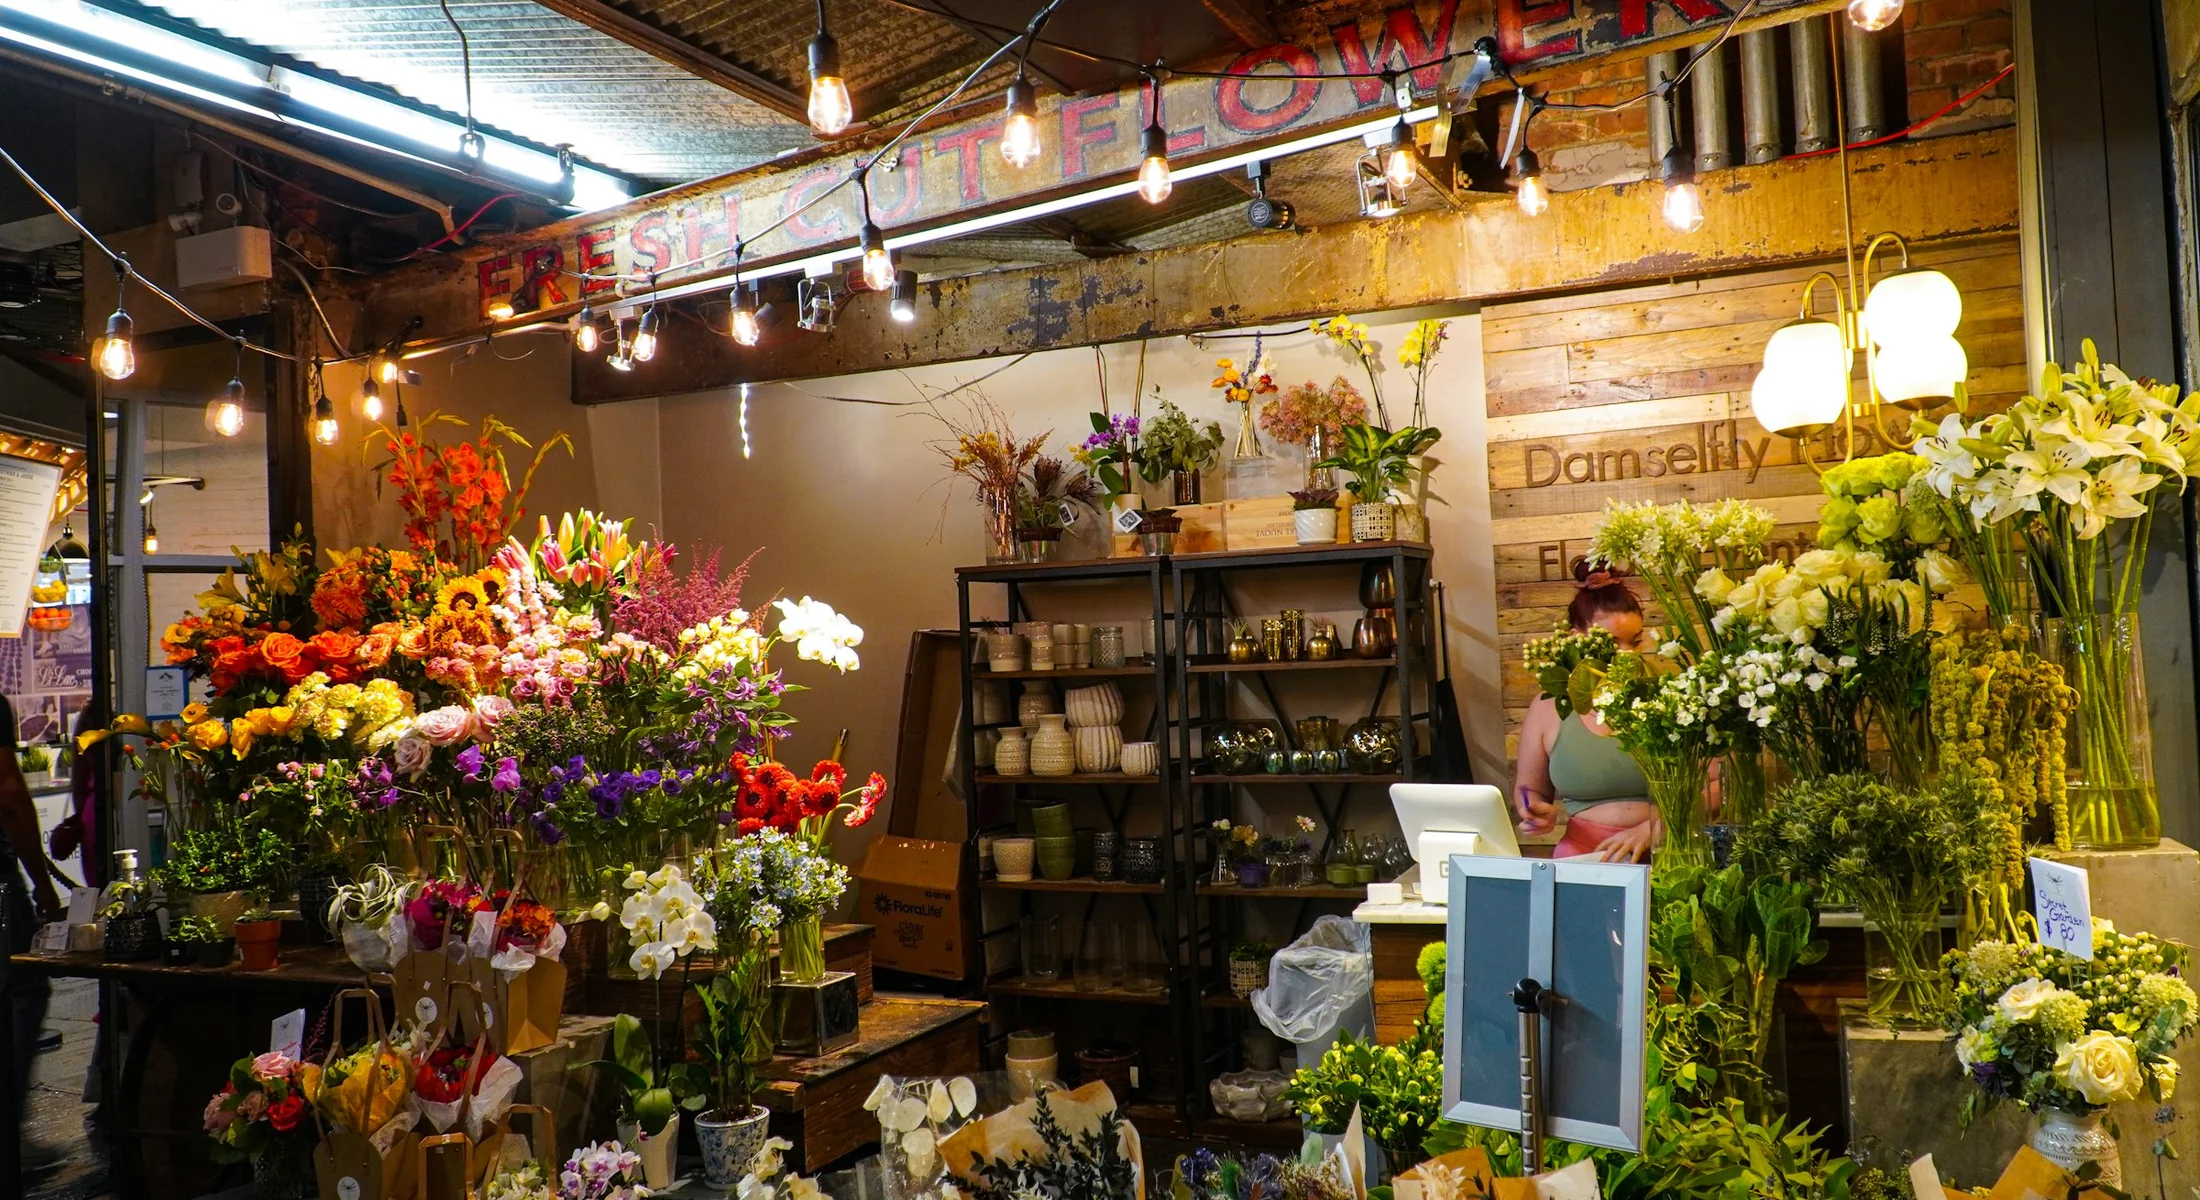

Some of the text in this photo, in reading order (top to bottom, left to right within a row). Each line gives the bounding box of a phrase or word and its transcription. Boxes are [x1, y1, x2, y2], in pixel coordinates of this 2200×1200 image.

[477, 189, 743, 322] FRESH
[782, 118, 1006, 241] CUT
[1524, 418, 1771, 488] Damselfly
[894, 901, 942, 918] FloraLife
[2049, 907, 2085, 928] Garden
[2060, 923, 2075, 942] 80
